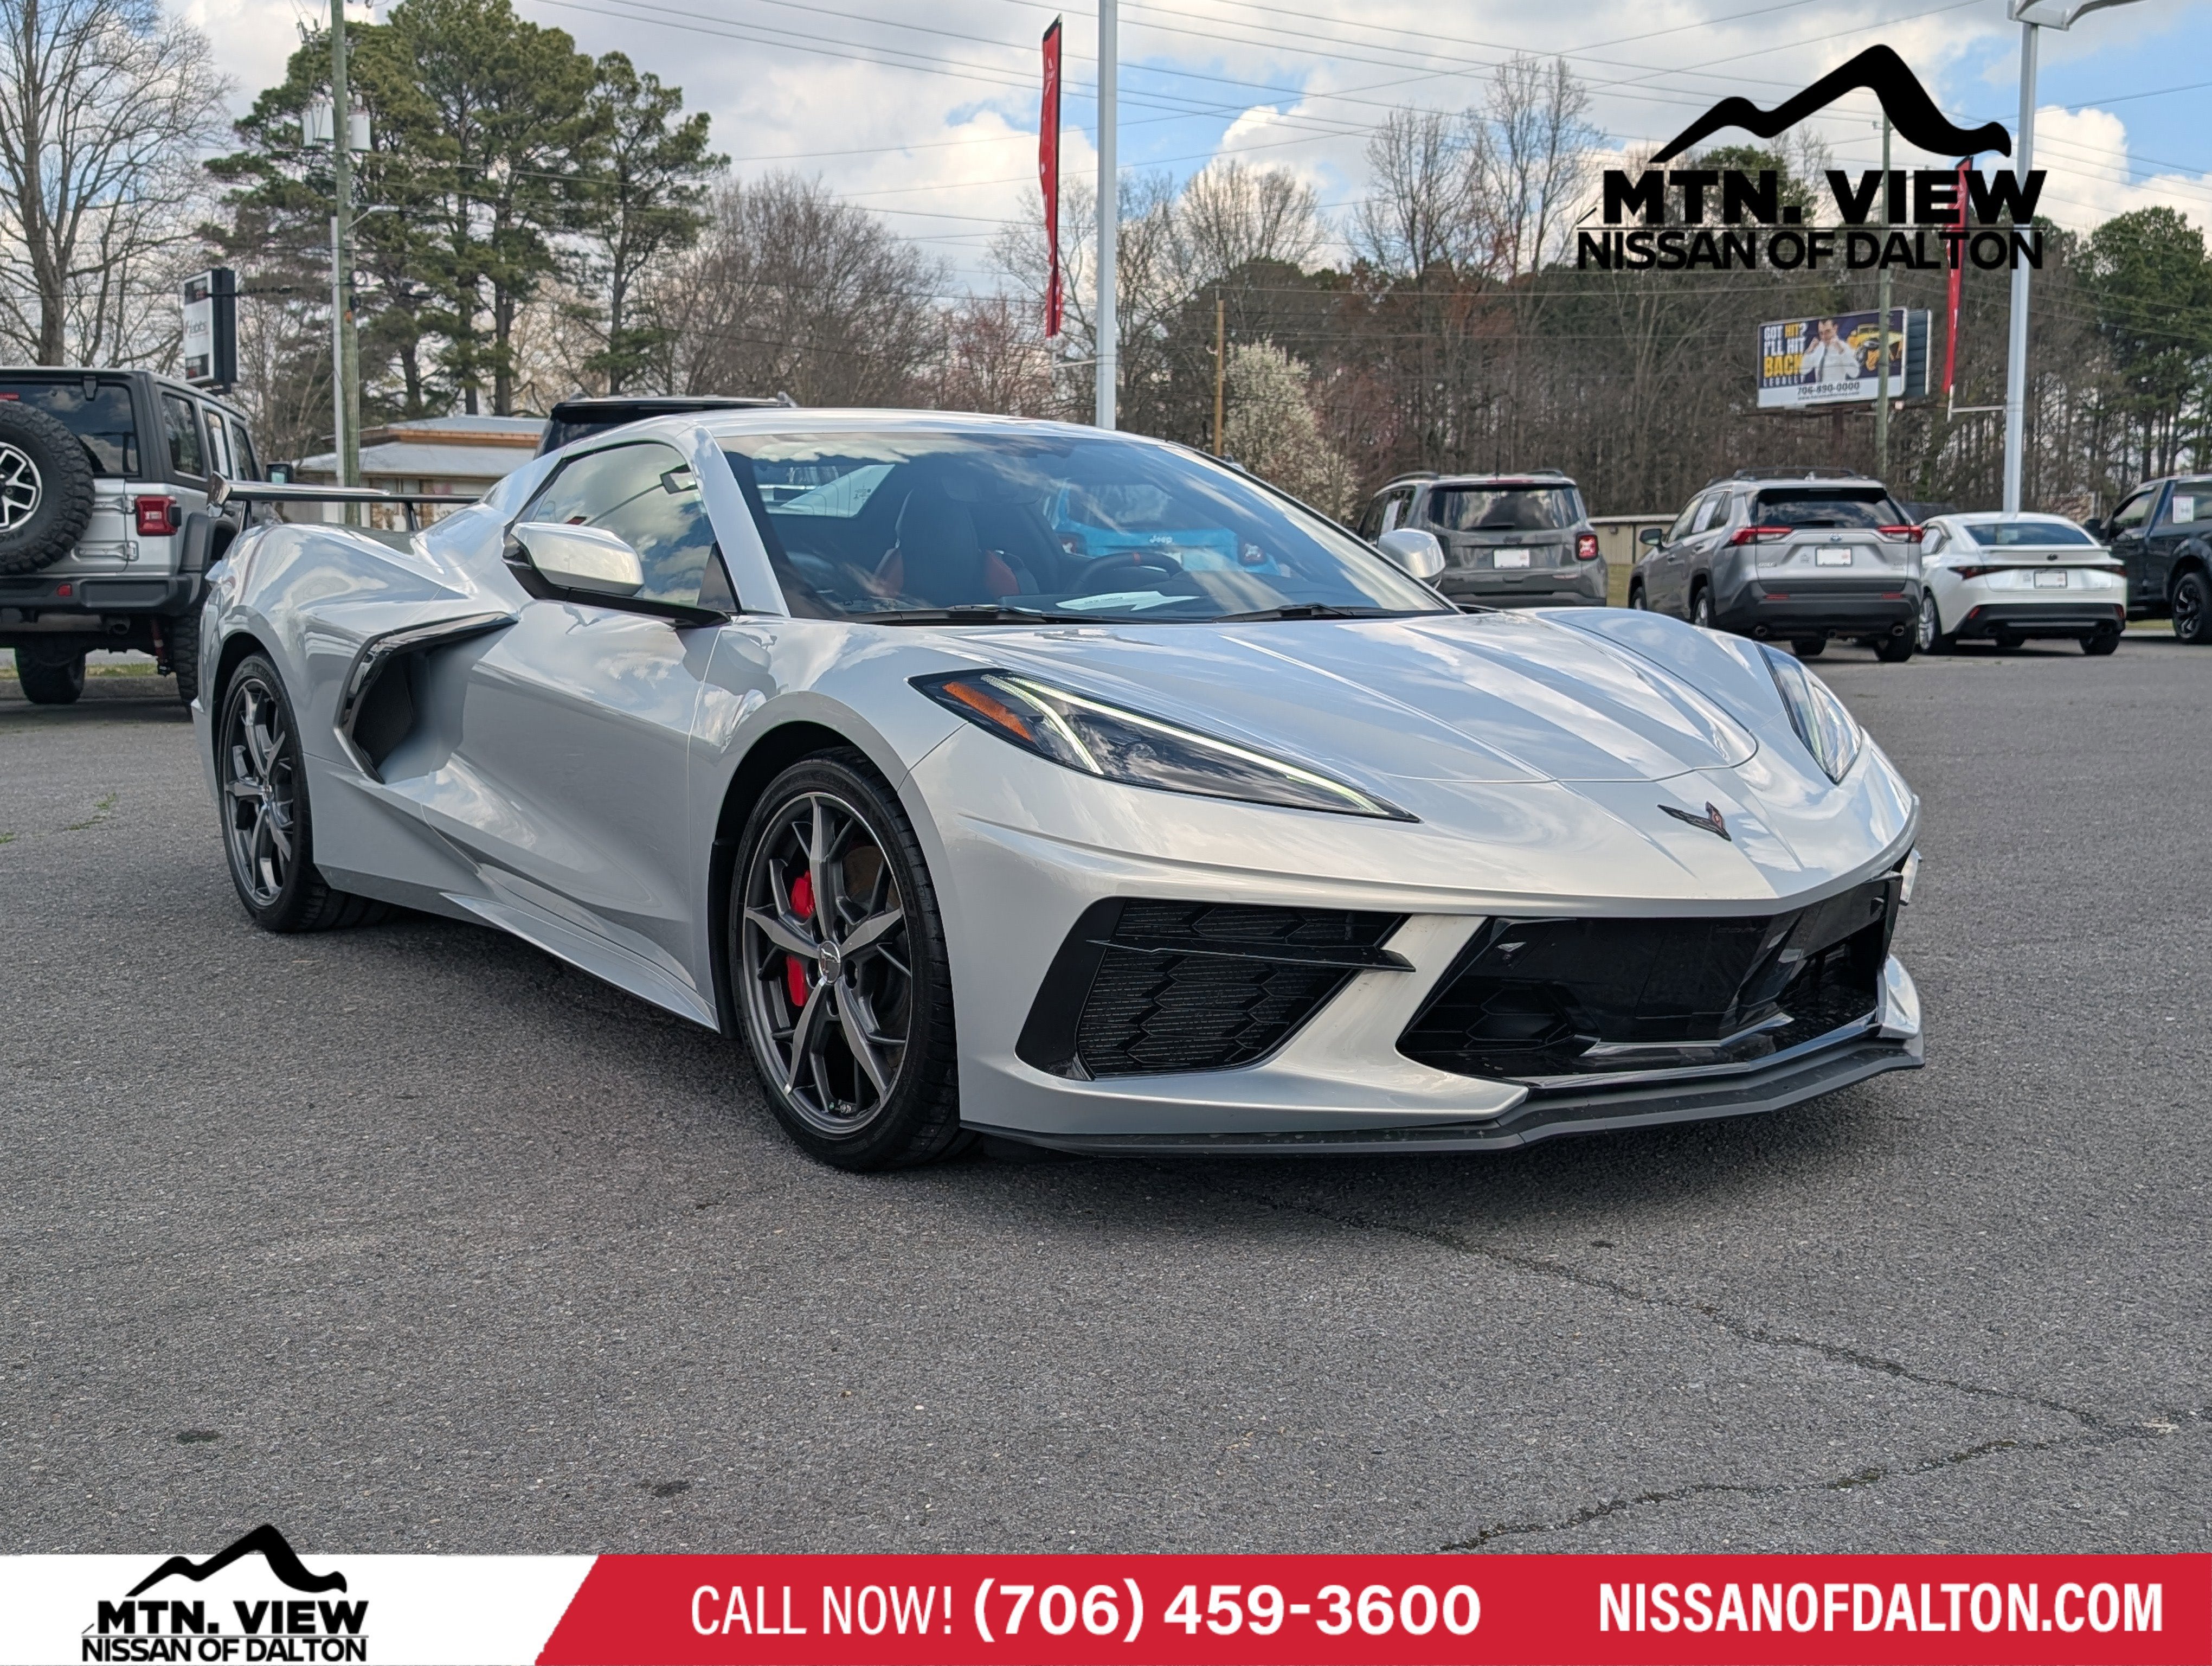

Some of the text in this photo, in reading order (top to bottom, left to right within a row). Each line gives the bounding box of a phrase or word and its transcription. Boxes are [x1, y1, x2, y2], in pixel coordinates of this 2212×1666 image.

[1764, 325, 1784, 341] GOT
[1787, 337, 1805, 354] HIT
[1764, 353, 1803, 379] BACK
[1149, 535, 1173, 544] Jeep
